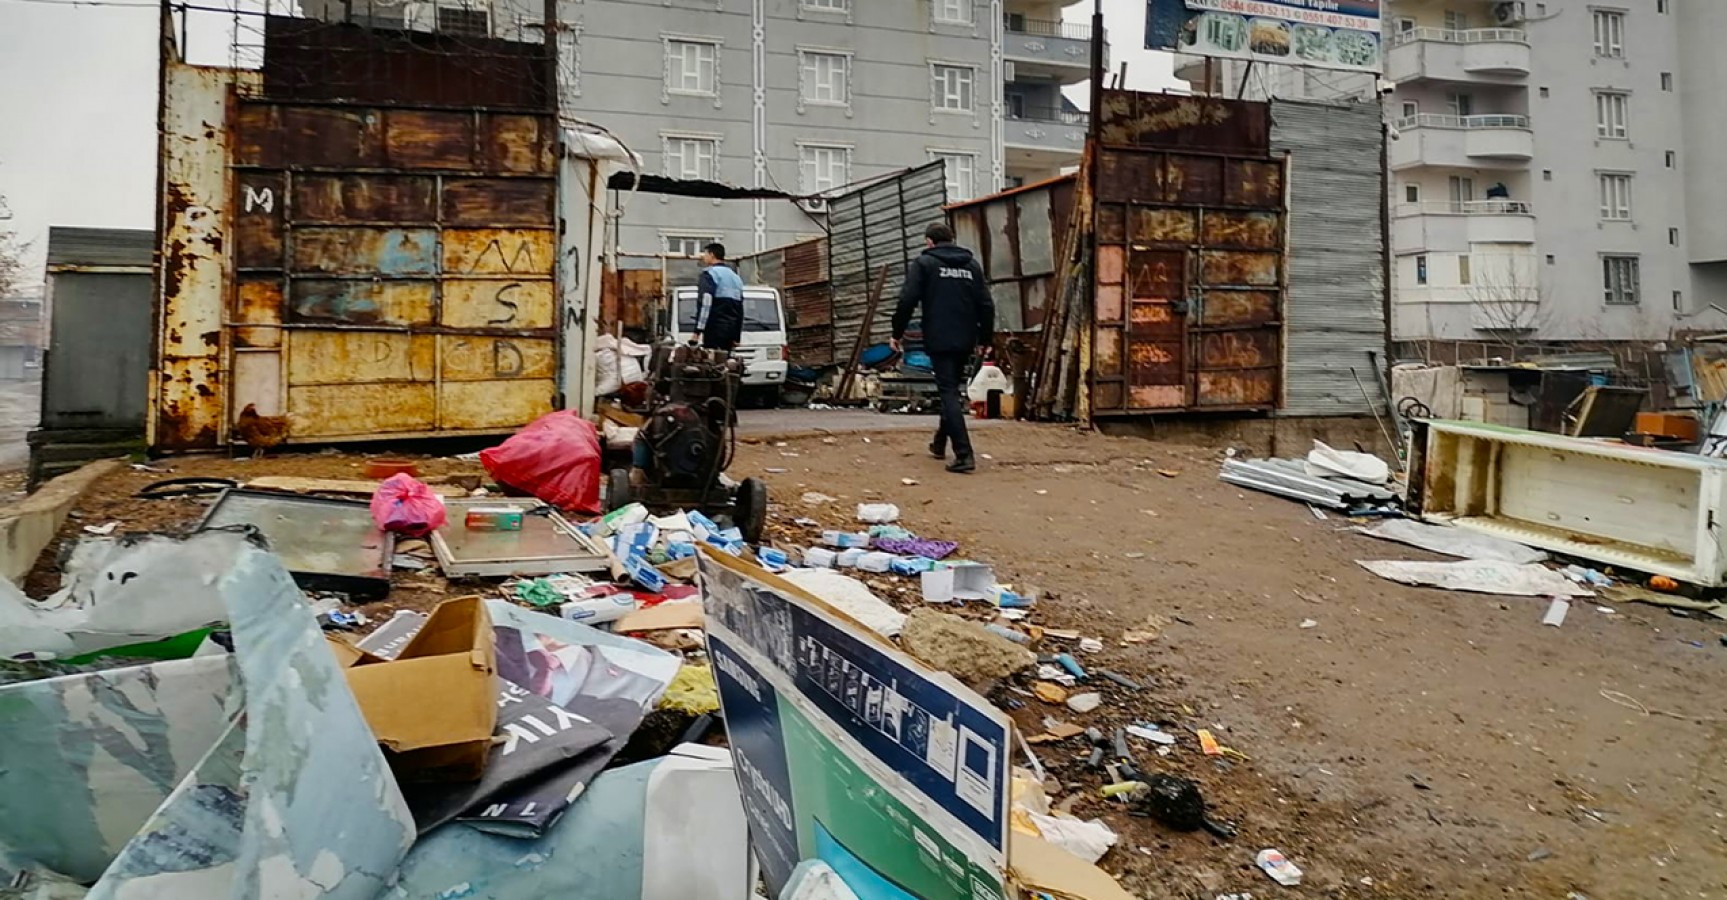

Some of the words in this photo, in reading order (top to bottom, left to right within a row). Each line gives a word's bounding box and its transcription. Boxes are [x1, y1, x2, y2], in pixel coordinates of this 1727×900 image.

[243, 186, 273, 213] M
[939, 266, 974, 280] ZABITA
[488, 282, 523, 326] S
